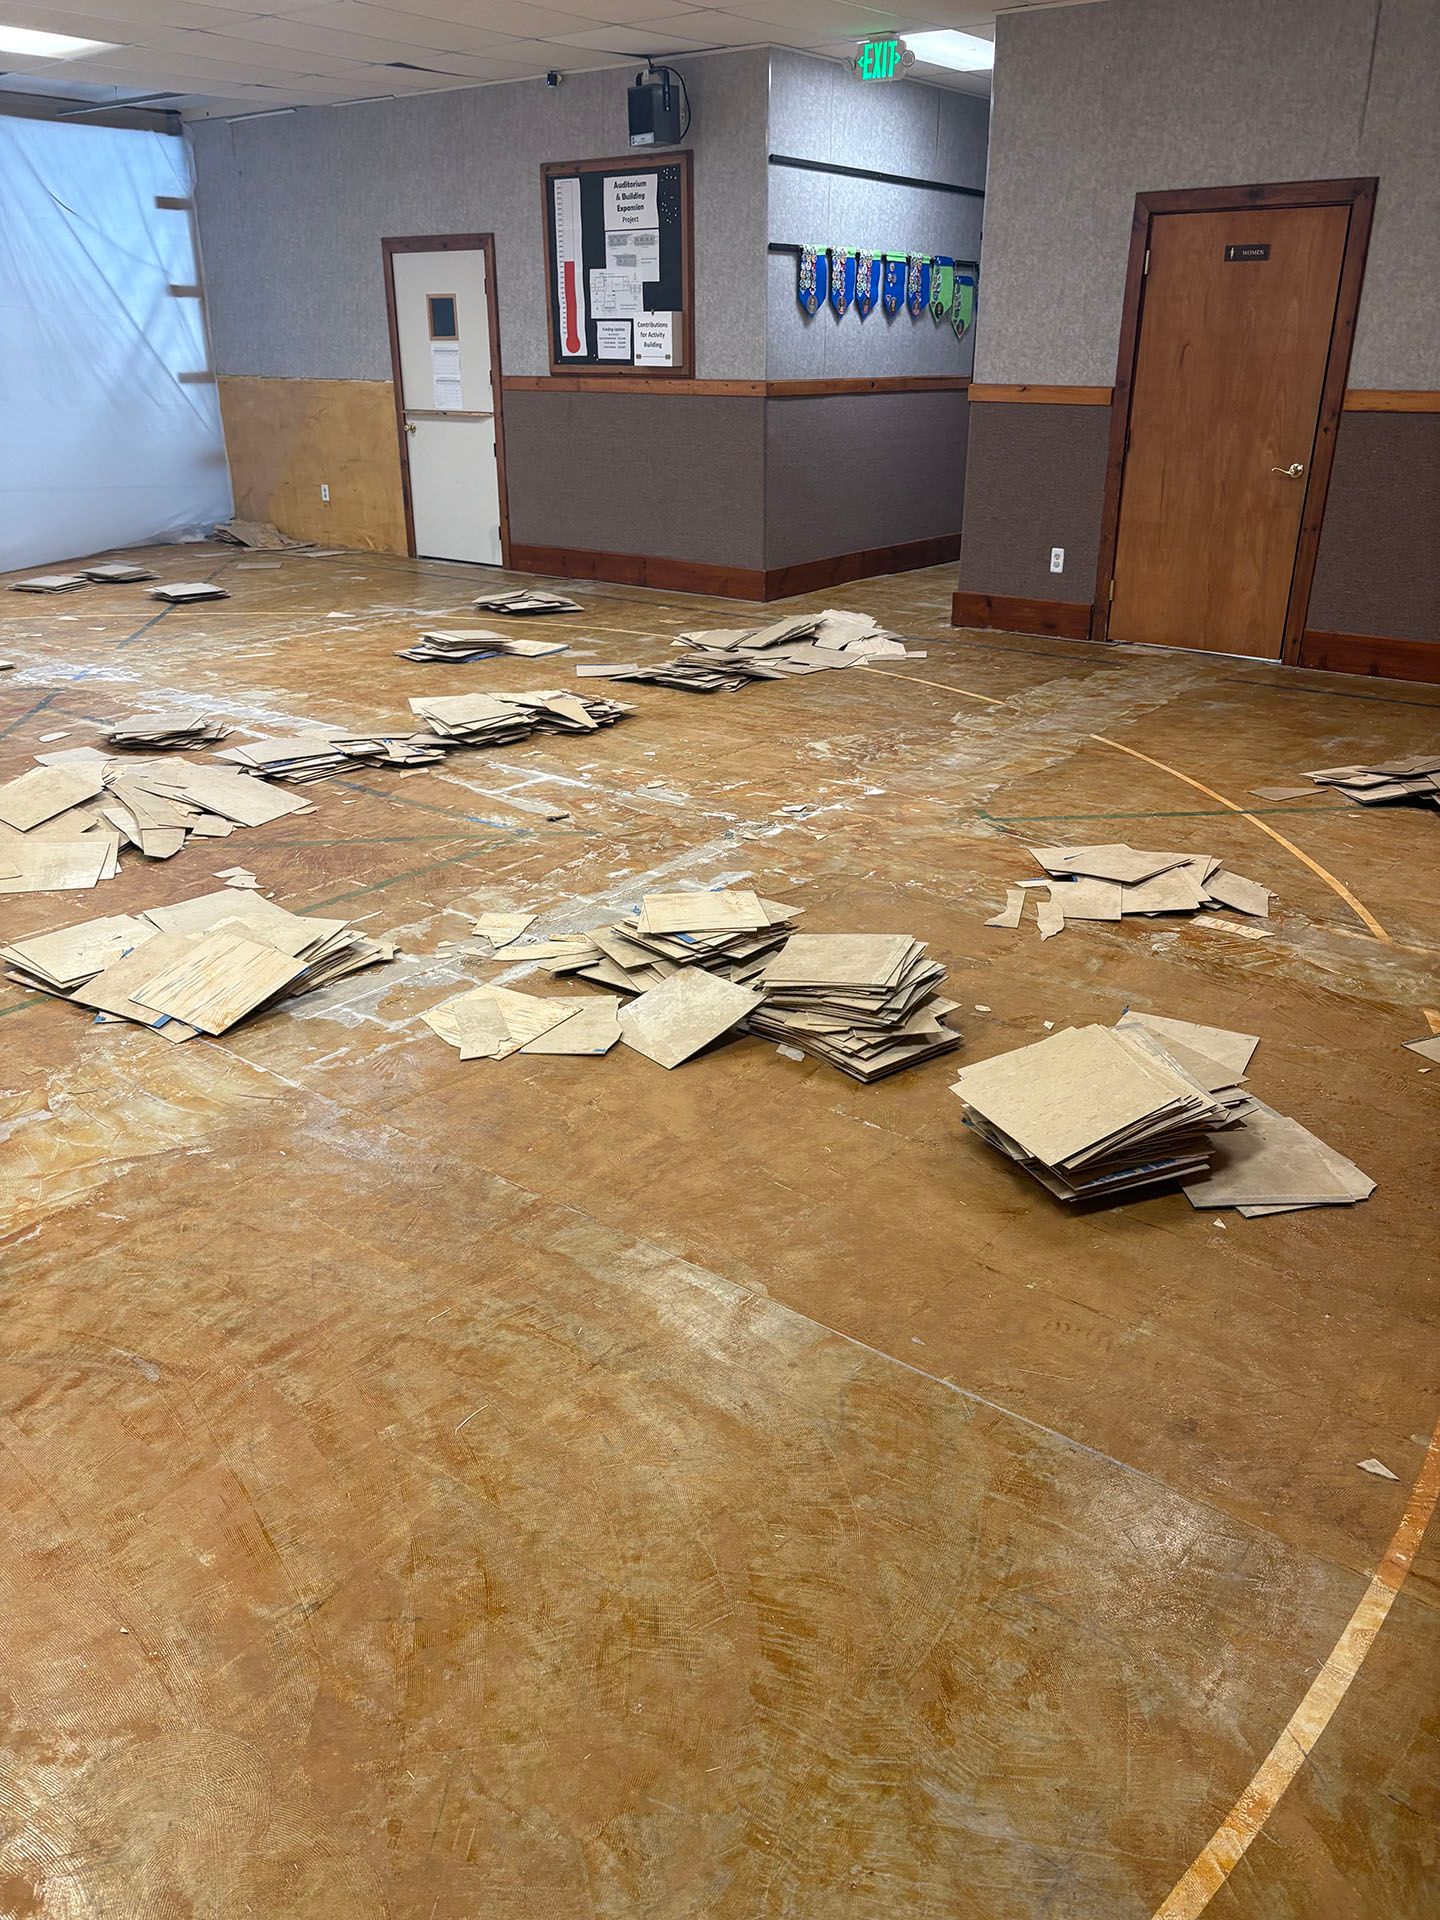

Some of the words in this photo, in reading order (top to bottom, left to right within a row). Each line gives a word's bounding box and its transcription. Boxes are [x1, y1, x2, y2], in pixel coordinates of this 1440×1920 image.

[862, 40, 897, 80] EXIT
[613, 180, 647, 189] Auditorium
[615, 193, 621, 201] &
[621, 192, 645, 200] Building
[616, 204, 644, 212] Expansion
[622, 216, 639, 224] Project
[648, 331, 665, 339] Activity
[643, 341, 662, 349] Building
